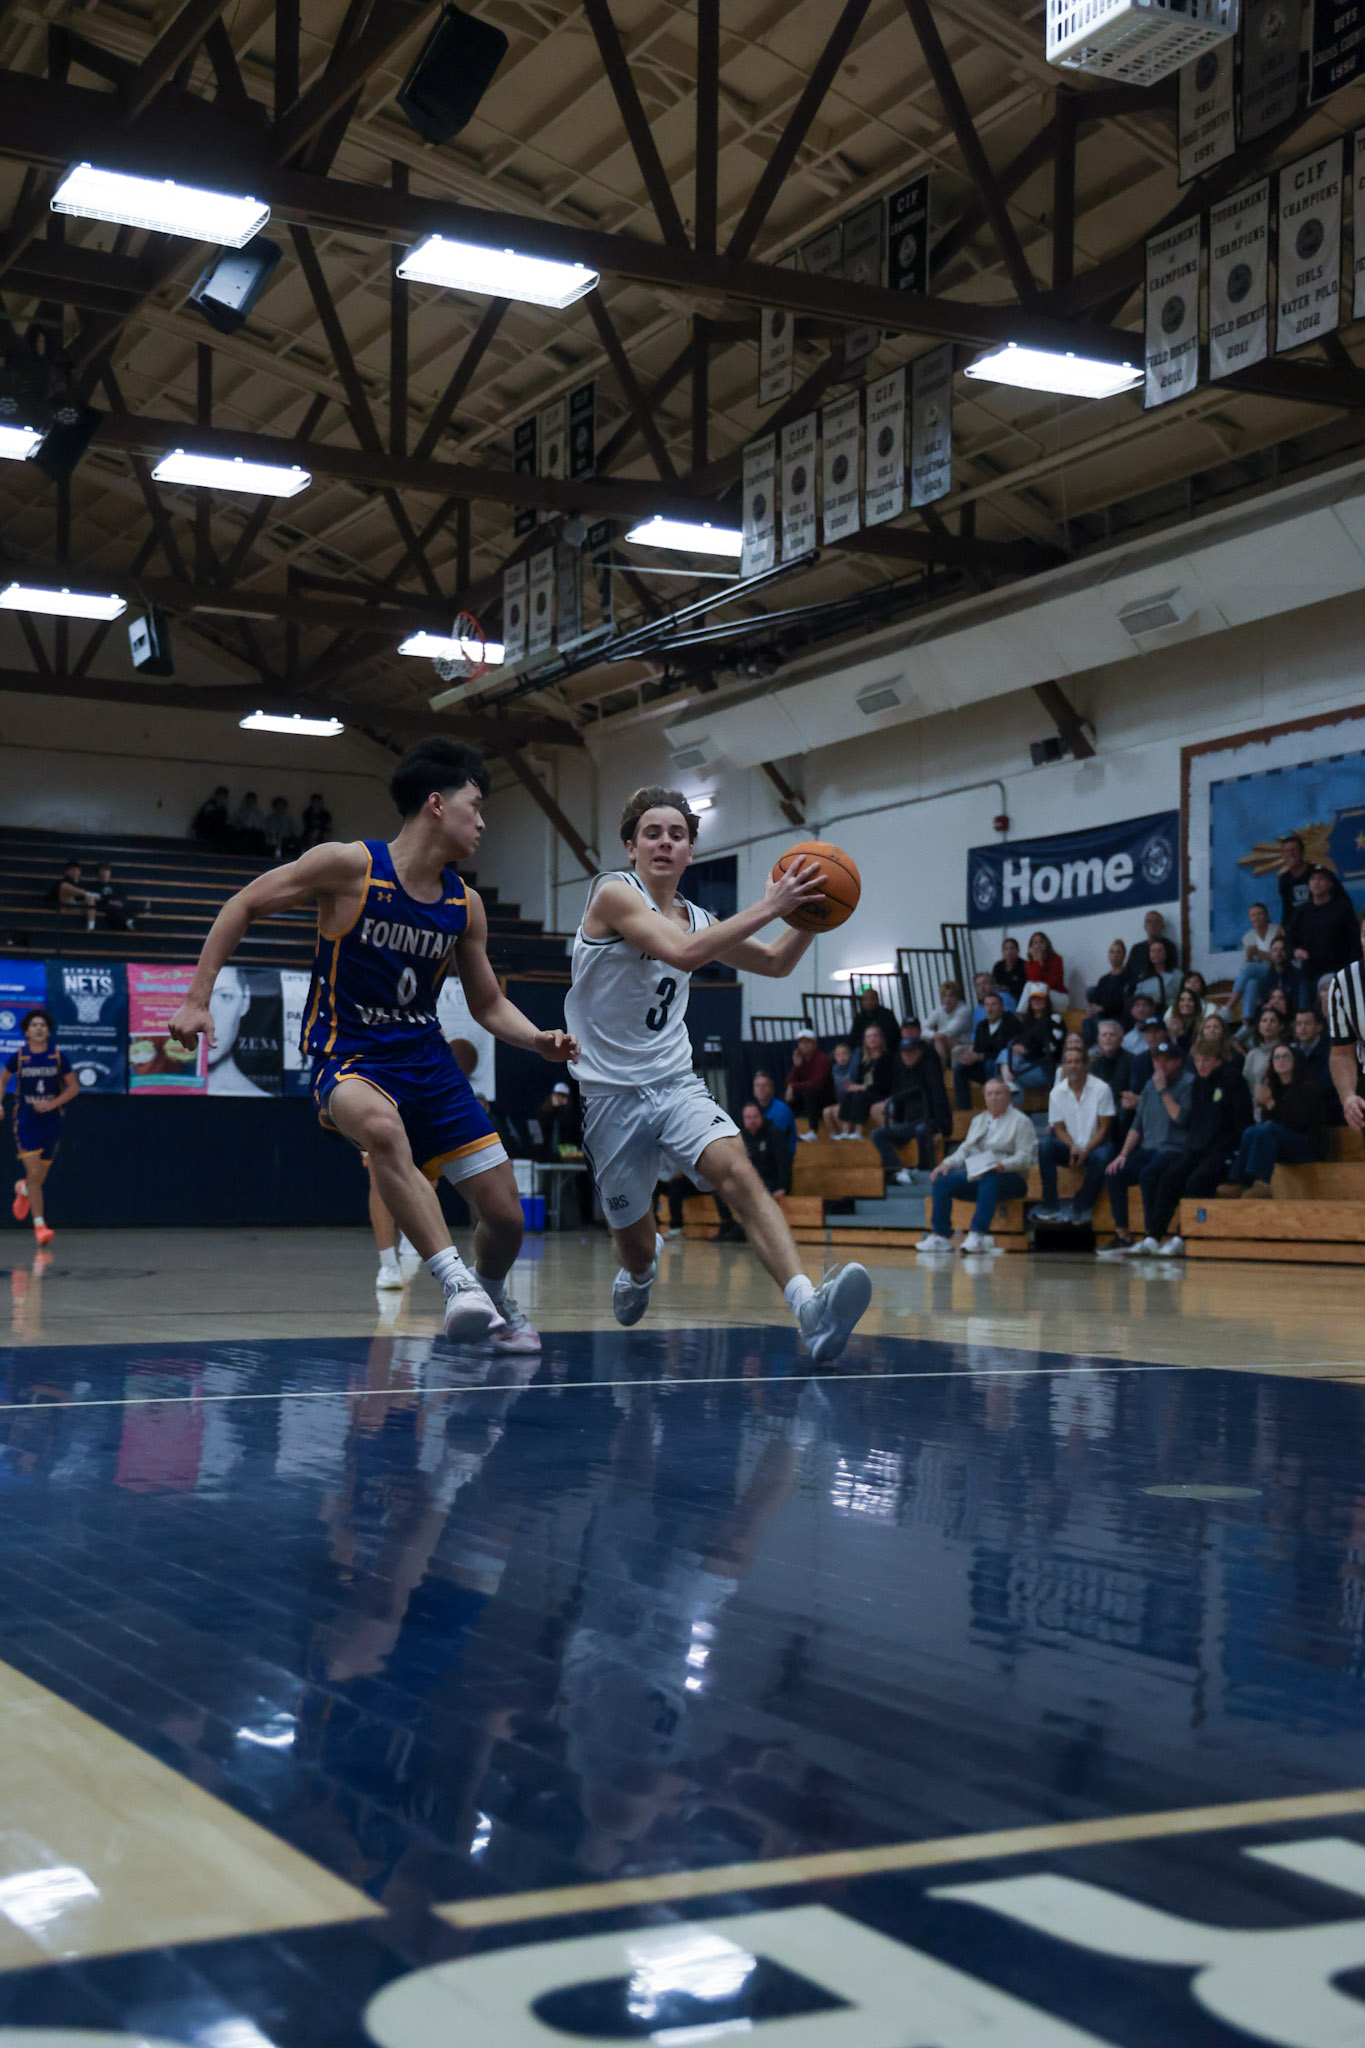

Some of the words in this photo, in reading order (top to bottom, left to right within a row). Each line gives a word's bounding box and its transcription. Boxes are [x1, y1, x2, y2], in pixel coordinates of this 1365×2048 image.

[1294, 160, 1327, 190] CIF
[897, 189, 919, 213] CIF
[1212, 187, 1267, 225] TOURNAMENT
[1283, 181, 1339, 219] CHAMPIONS
[1150, 221, 1199, 257] TOURNAMENT
[1215, 225, 1265, 259] CHAMPIONS
[1150, 259, 1198, 292] CHAMPIONS
[1296, 265, 1323, 287] GIRLS
[1281, 295, 1310, 316] WATER
[1315, 280, 1338, 303] POLO
[1212, 320, 1234, 338] FIELD
[1236, 304, 1267, 330] HOCKEY
[1296, 312, 1321, 333] 2012
[1149, 351, 1168, 368] FIELD
[1170, 336, 1197, 361] HOCKEY
[1227, 341, 1248, 360] 2011
[876, 382, 896, 403] CIF
[789, 425, 808, 444] CIF
[1002, 852, 1134, 908] Home
[63, 975, 114, 996] NETS
[397, 967, 417, 1006] 0
[645, 977, 677, 1031] 3
[36, 1079, 45, 1093] 4
